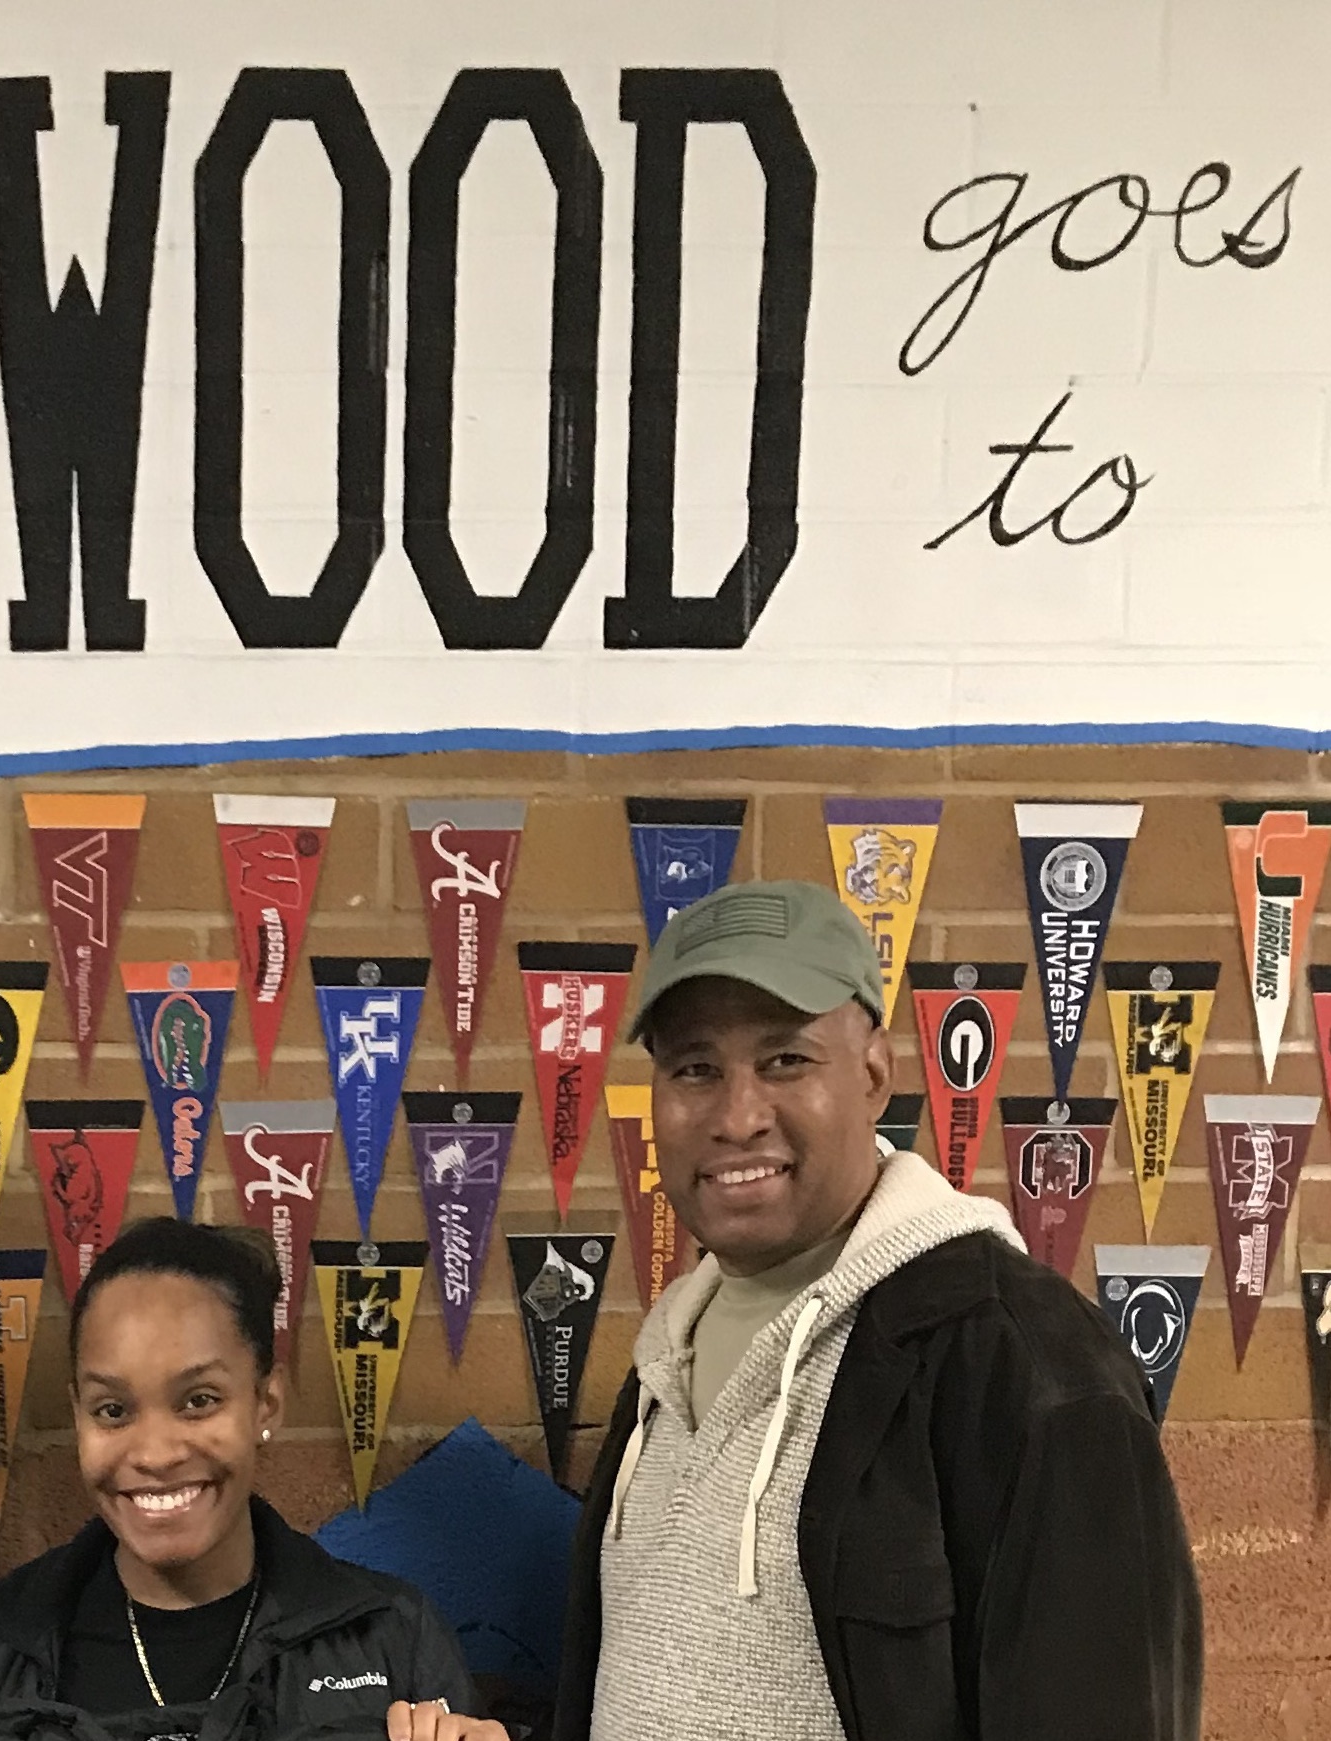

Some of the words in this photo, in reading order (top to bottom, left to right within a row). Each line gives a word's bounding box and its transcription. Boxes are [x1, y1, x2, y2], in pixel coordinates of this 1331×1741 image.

[898, 160, 1302, 376] goes
[923, 391, 1157, 549] to
[257, 907, 285, 1004] WISCONSIN
[458, 902, 478, 985] CRIMSON
[1256, 898, 1282, 1000] HURRICANES
[1280, 906, 1292, 957] MIAMI
[457, 986, 475, 1032] TIDE
[560, 978, 581, 1059] HUSKERS
[1041, 912, 1069, 1048] UNIVERSITY
[1064, 919, 1101, 1043] HOWARD
[355, 1085, 373, 1186] KENTUCKY
[553, 1064, 582, 1159] Nebraska
[947, 1097, 970, 1191] BULLDOGS
[1143, 1079, 1160, 1177] MISSOURI
[1158, 1079, 1170, 1157] UNIVERSITY
[652, 1191, 666, 1250] GOLDEN
[1250, 1142, 1271, 1206] STATE
[438, 1203, 472, 1306] Wildcats
[353, 1353, 368, 1451] MISSOURI
[367, 1353, 378, 1430] UNIVERSITY
[553, 1325, 573, 1409] PURDUE
[323, 1671, 388, 1690] Columbia
